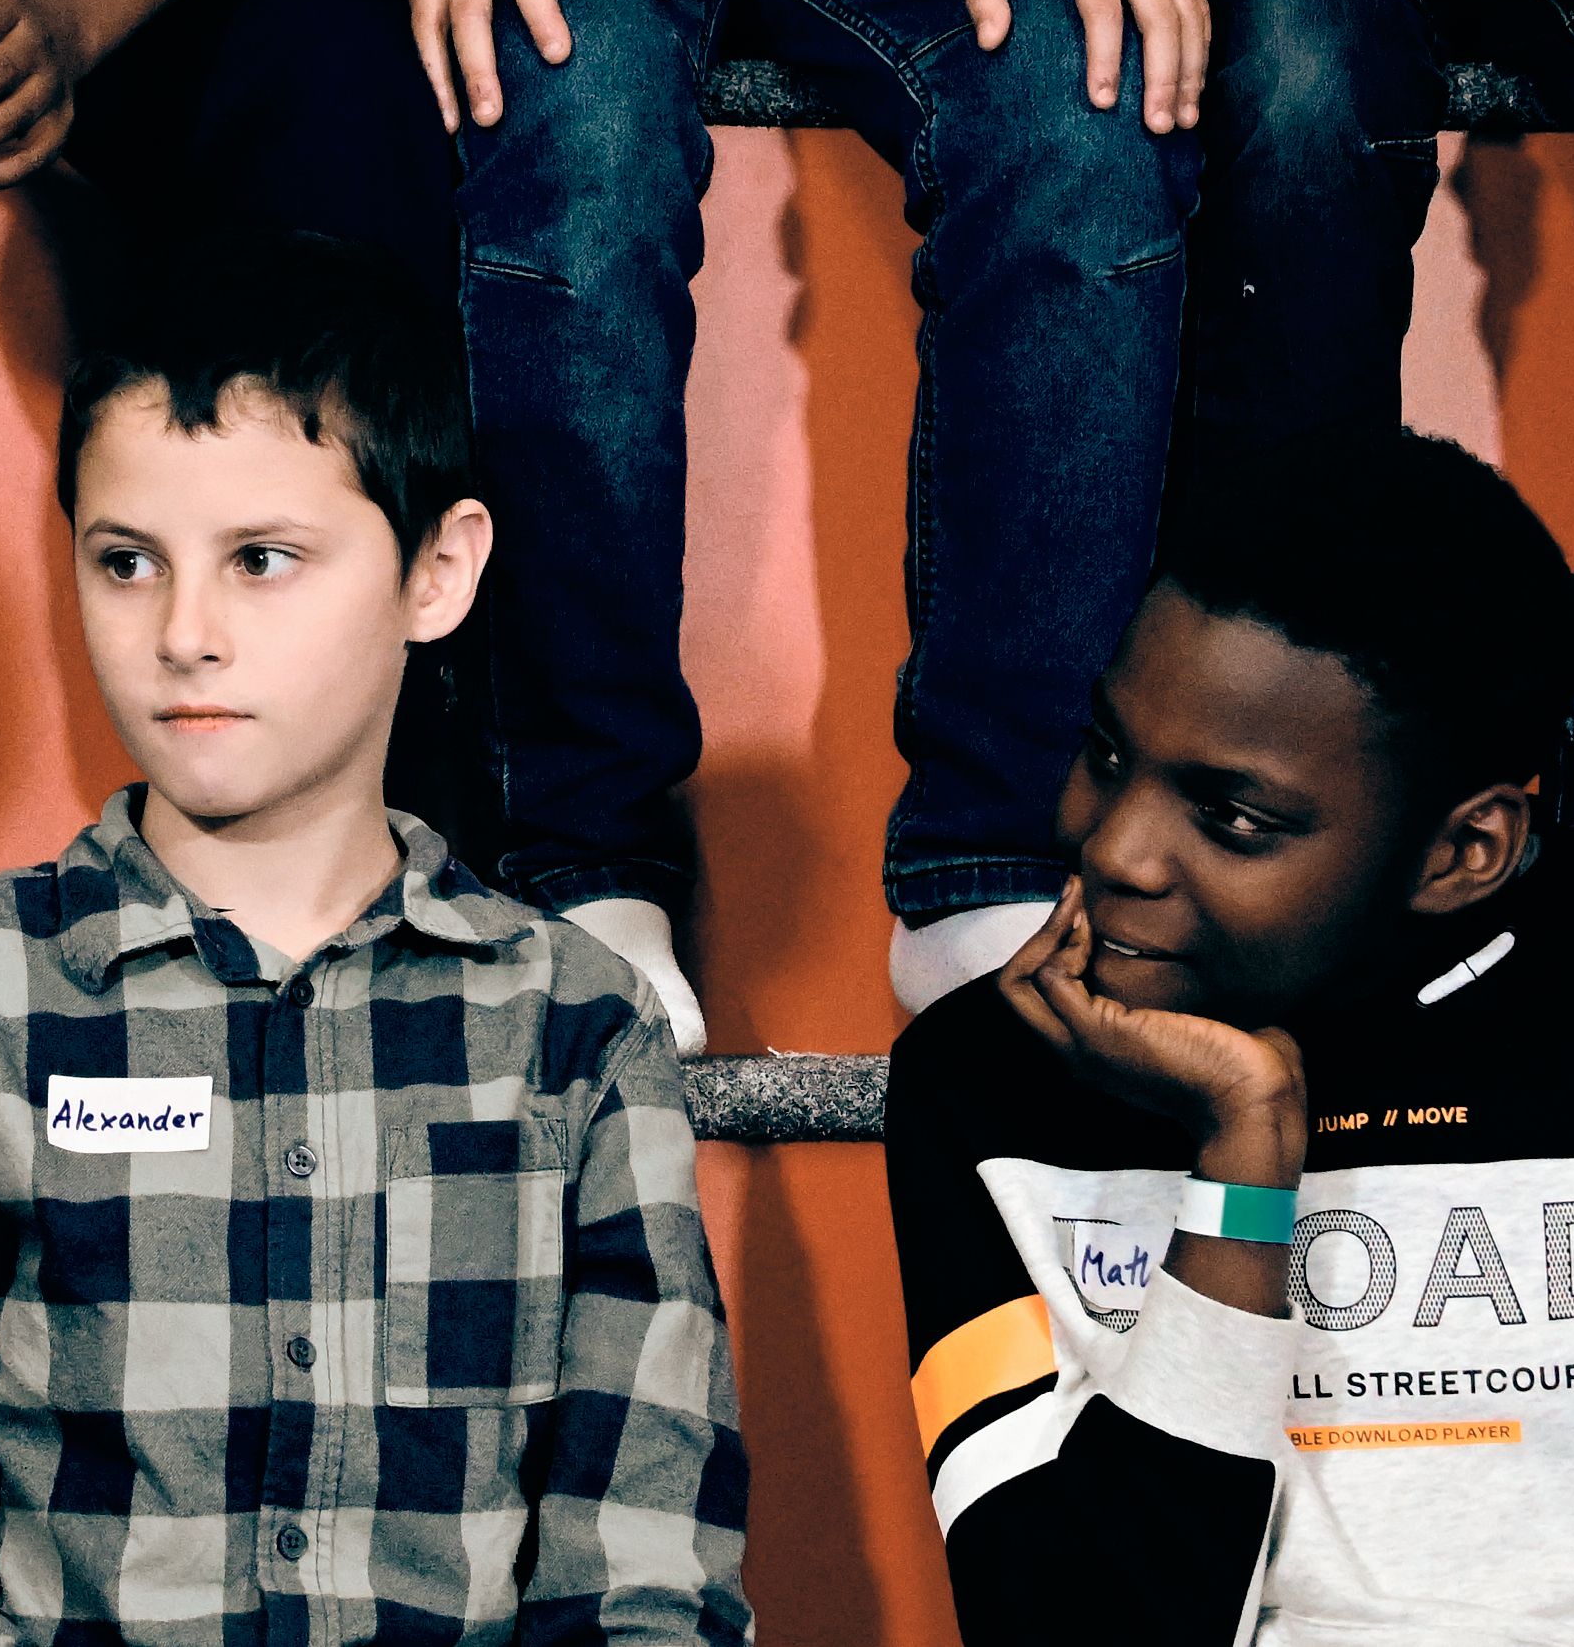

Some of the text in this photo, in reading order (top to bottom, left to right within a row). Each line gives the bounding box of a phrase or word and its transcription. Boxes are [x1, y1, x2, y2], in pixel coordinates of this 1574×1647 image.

[52, 1098, 204, 1131] Alexander
[1317, 1112, 1369, 1132] JUMP
[1408, 1106, 1468, 1125] MOVE
[1288, 1373, 1334, 1399] LL
[1329, 1428, 1438, 1445] DOWNLOAD
[1443, 1424, 1511, 1441] PLAYER
